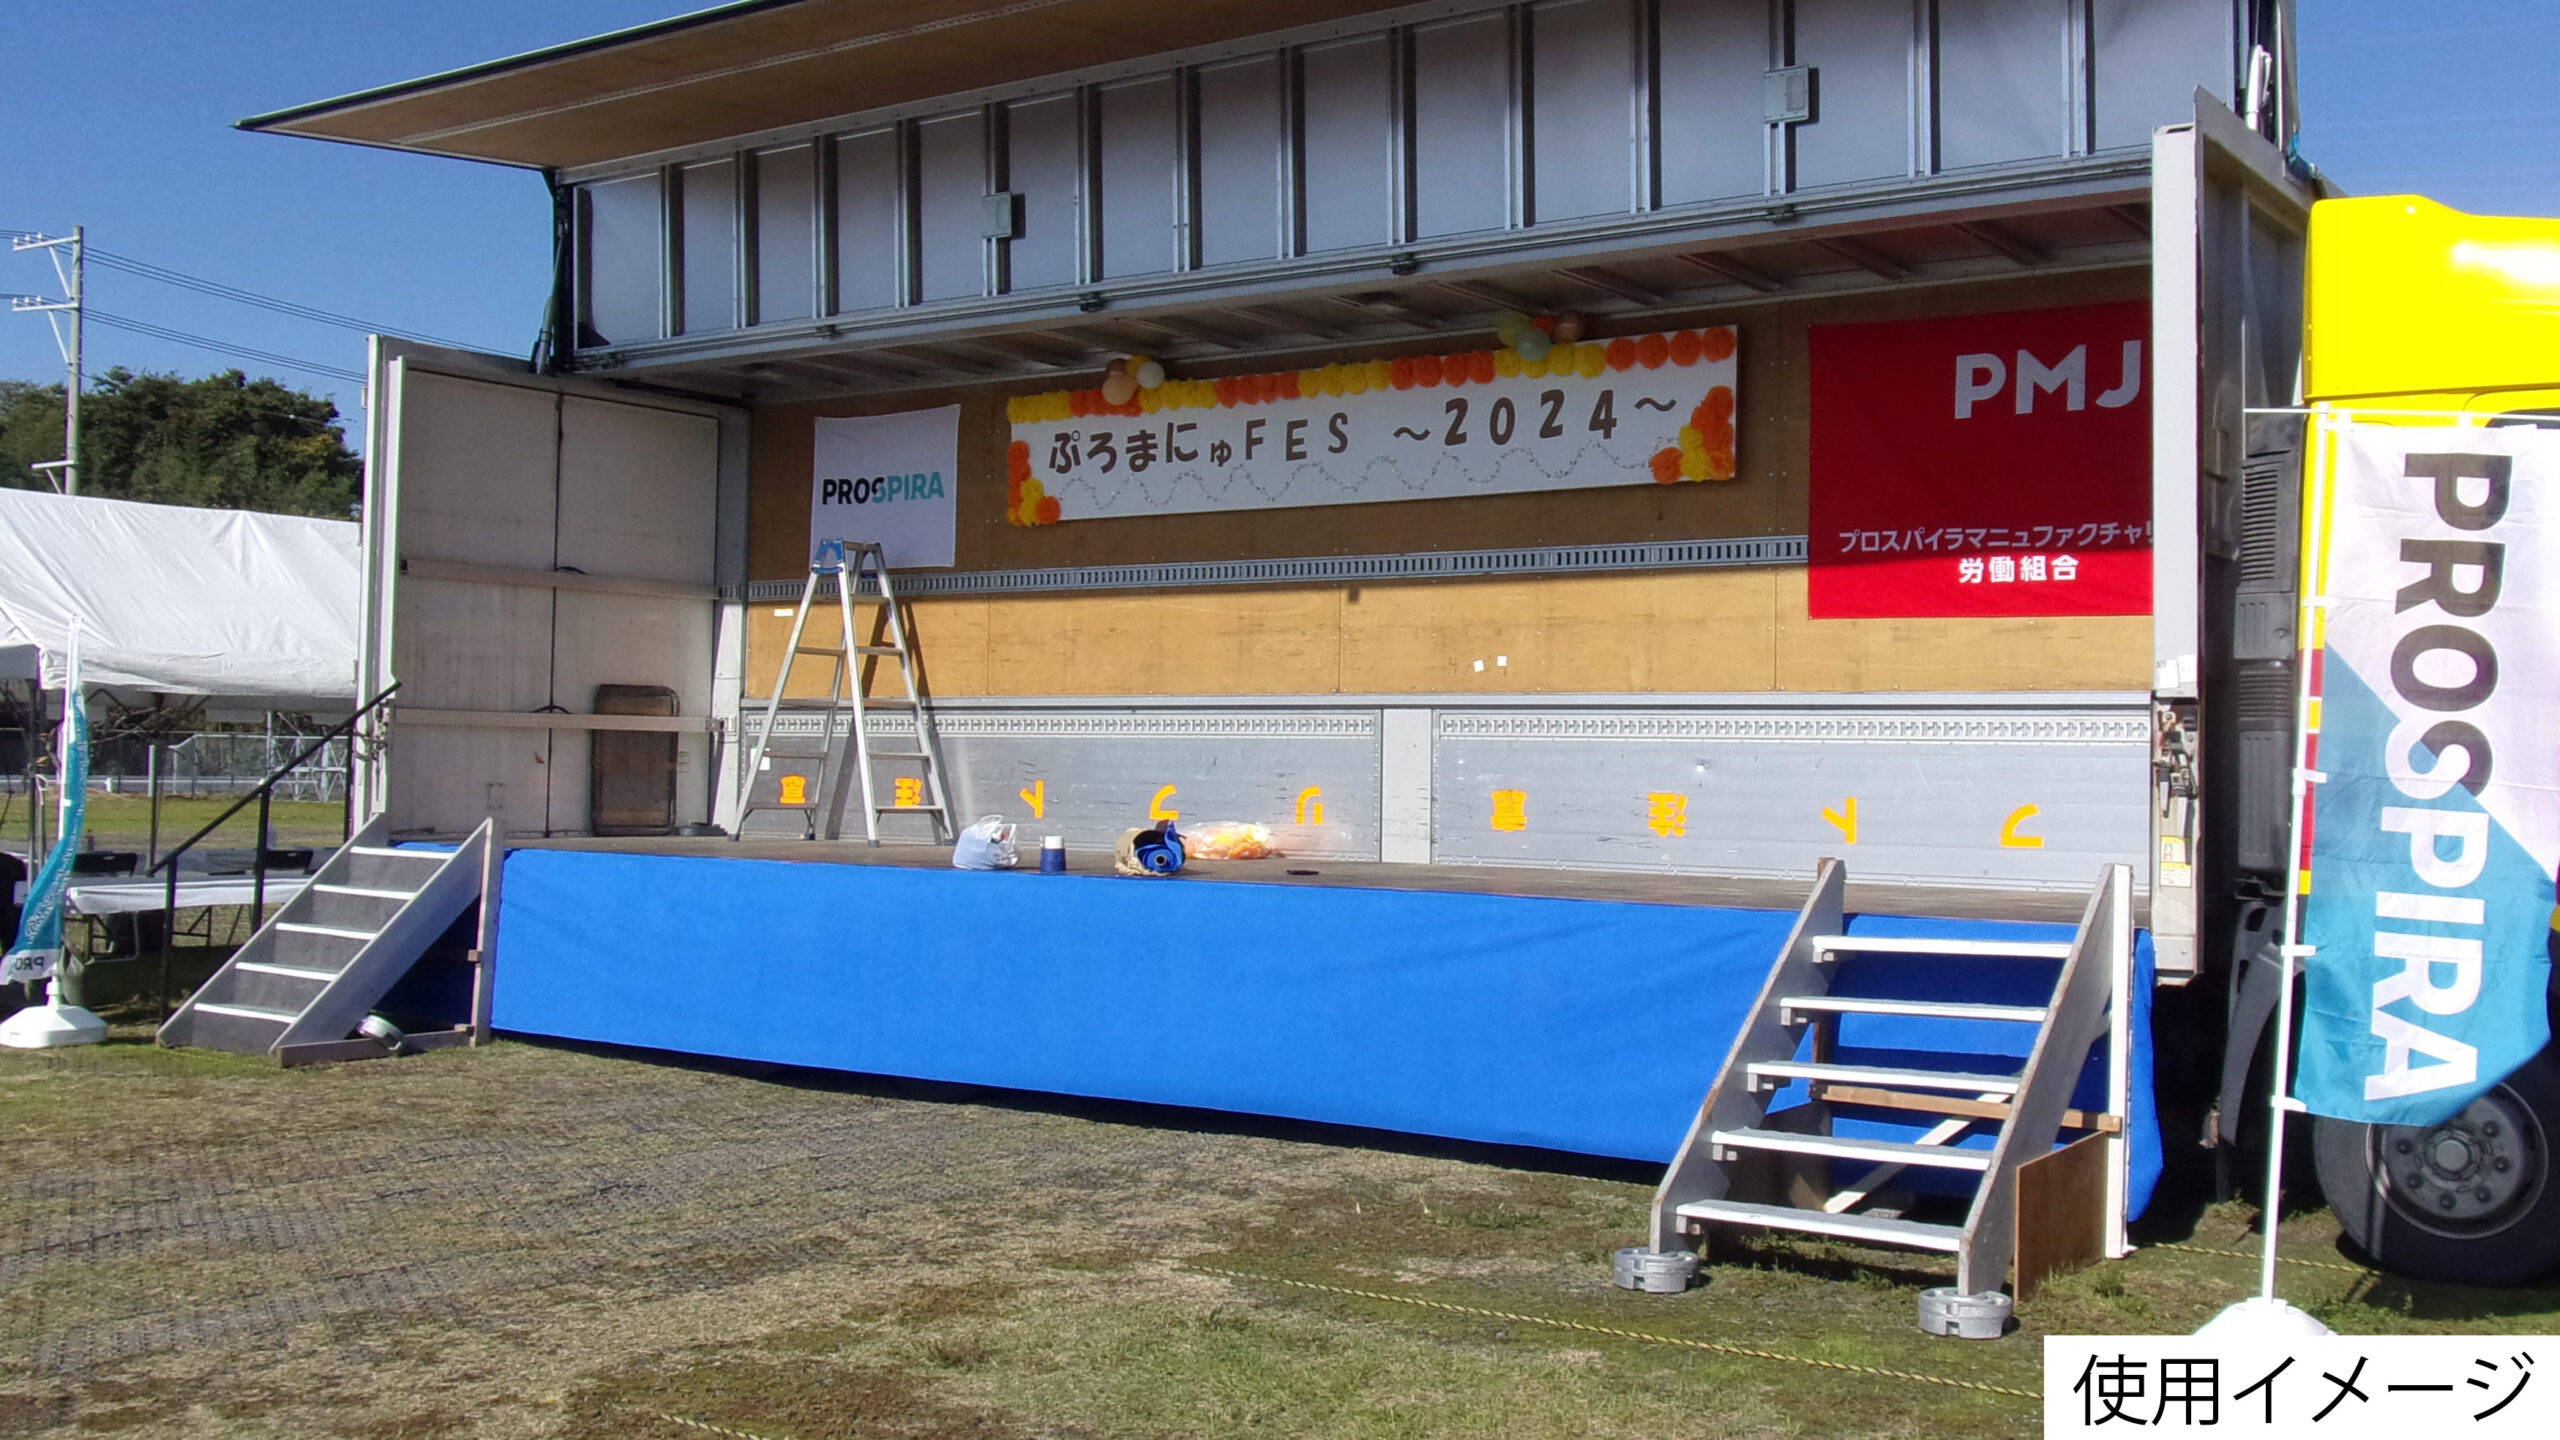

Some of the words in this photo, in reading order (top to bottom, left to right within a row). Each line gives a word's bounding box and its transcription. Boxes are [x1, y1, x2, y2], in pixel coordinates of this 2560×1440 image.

[1954, 339, 2143, 420] PMJ
[1048, 411, 1350, 476] ぷろまにゅFES
[822, 471, 945, 505] PROSPIRA
[1959, 554, 2079, 584] 労働組合
[2364, 453, 2512, 1100] PROSPIRA
